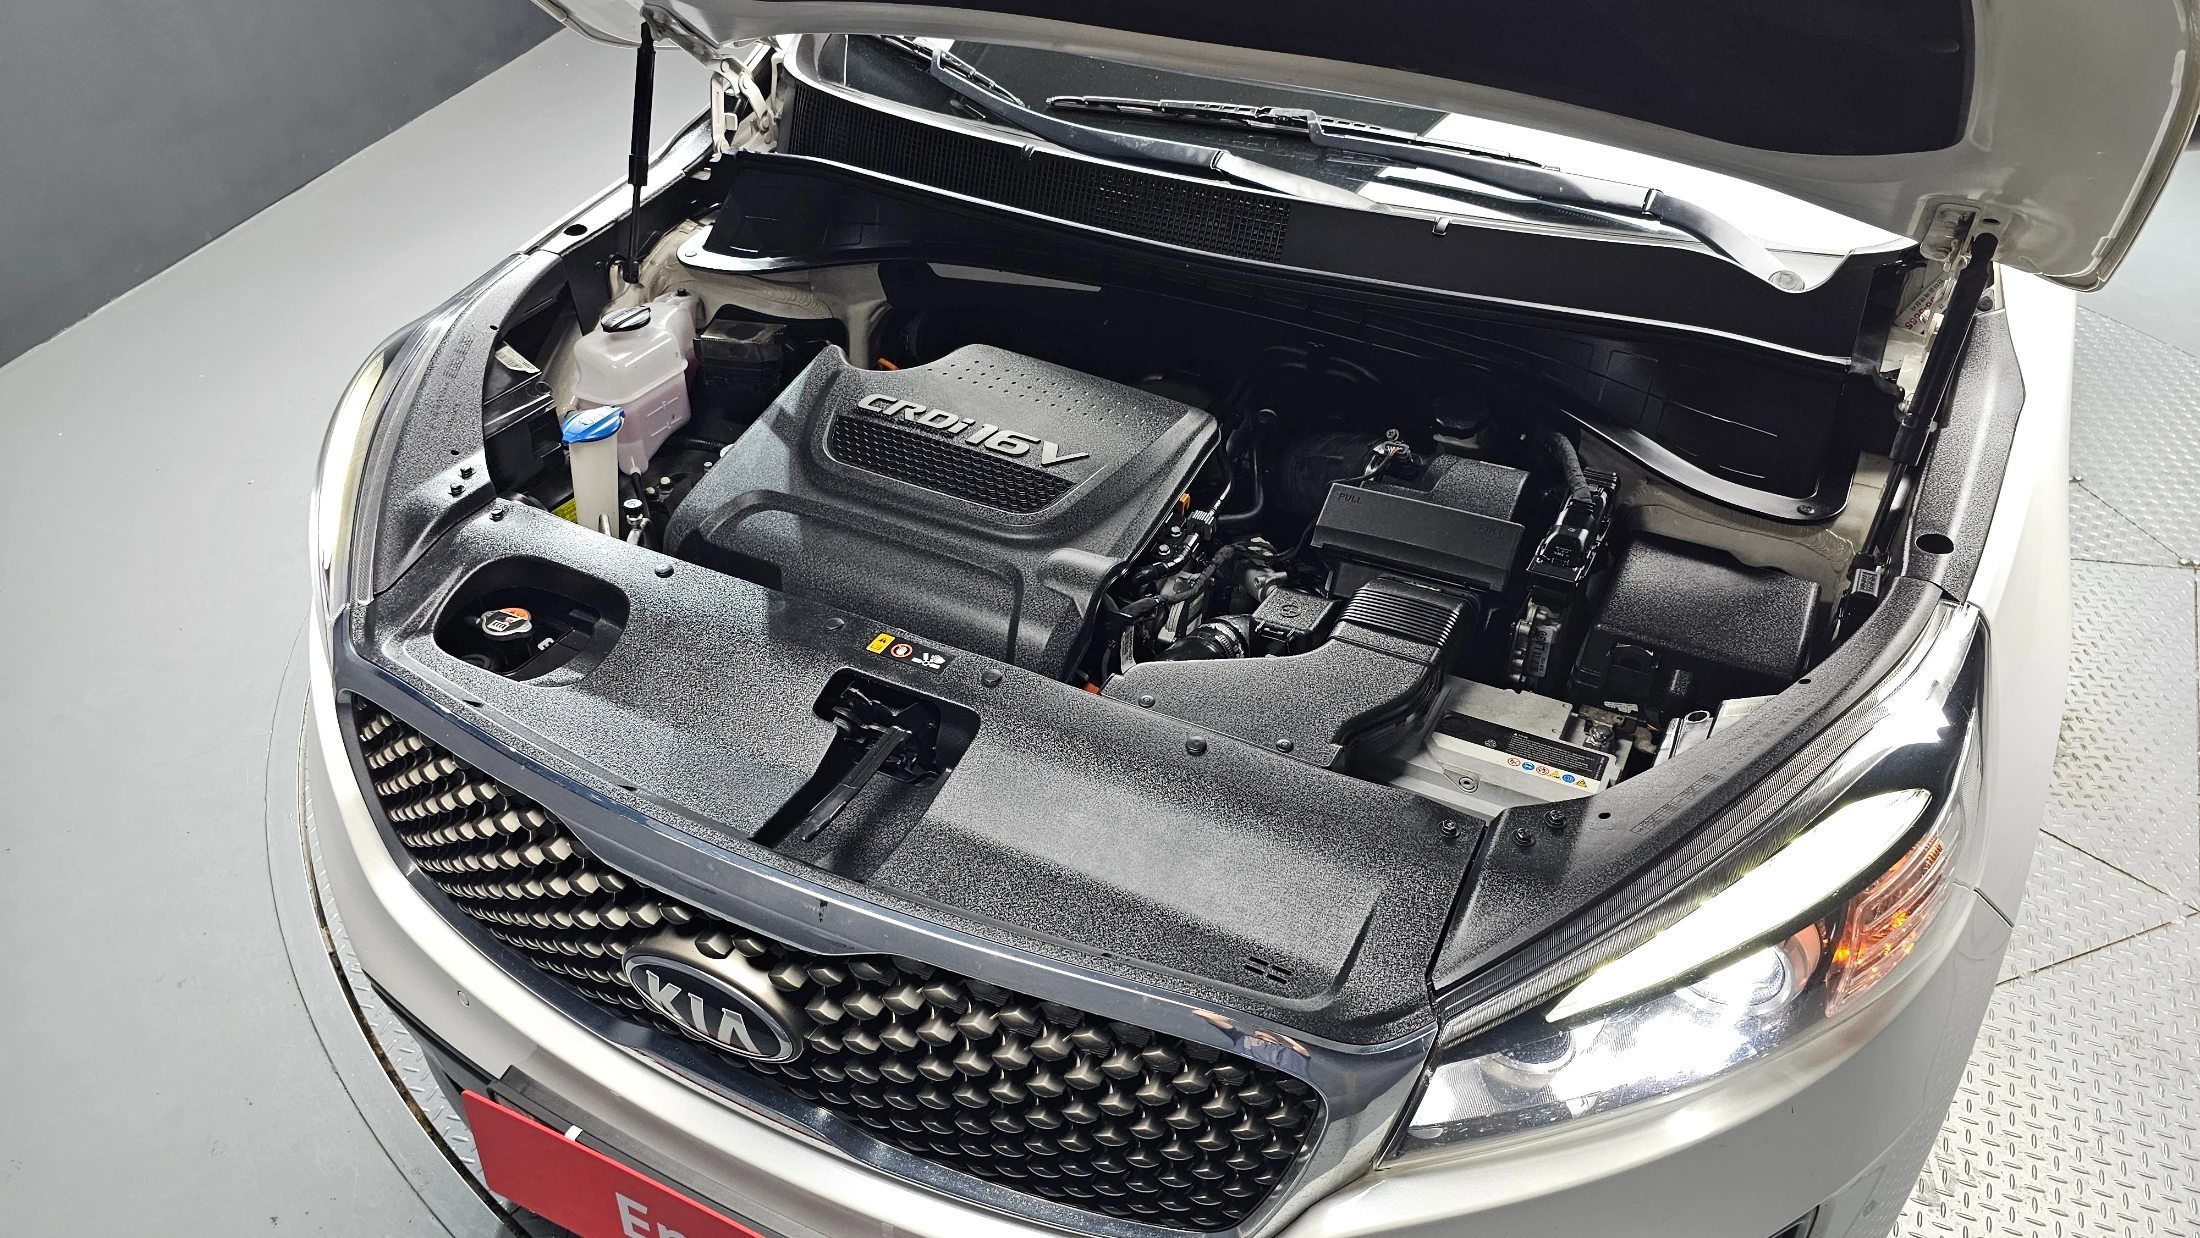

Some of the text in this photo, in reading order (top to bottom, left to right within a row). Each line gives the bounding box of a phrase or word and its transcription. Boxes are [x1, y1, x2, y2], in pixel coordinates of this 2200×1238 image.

[1337, 491, 1363, 505] PULL
[1478, 523, 1505, 537] PULL
[645, 969, 763, 1056] KIA
